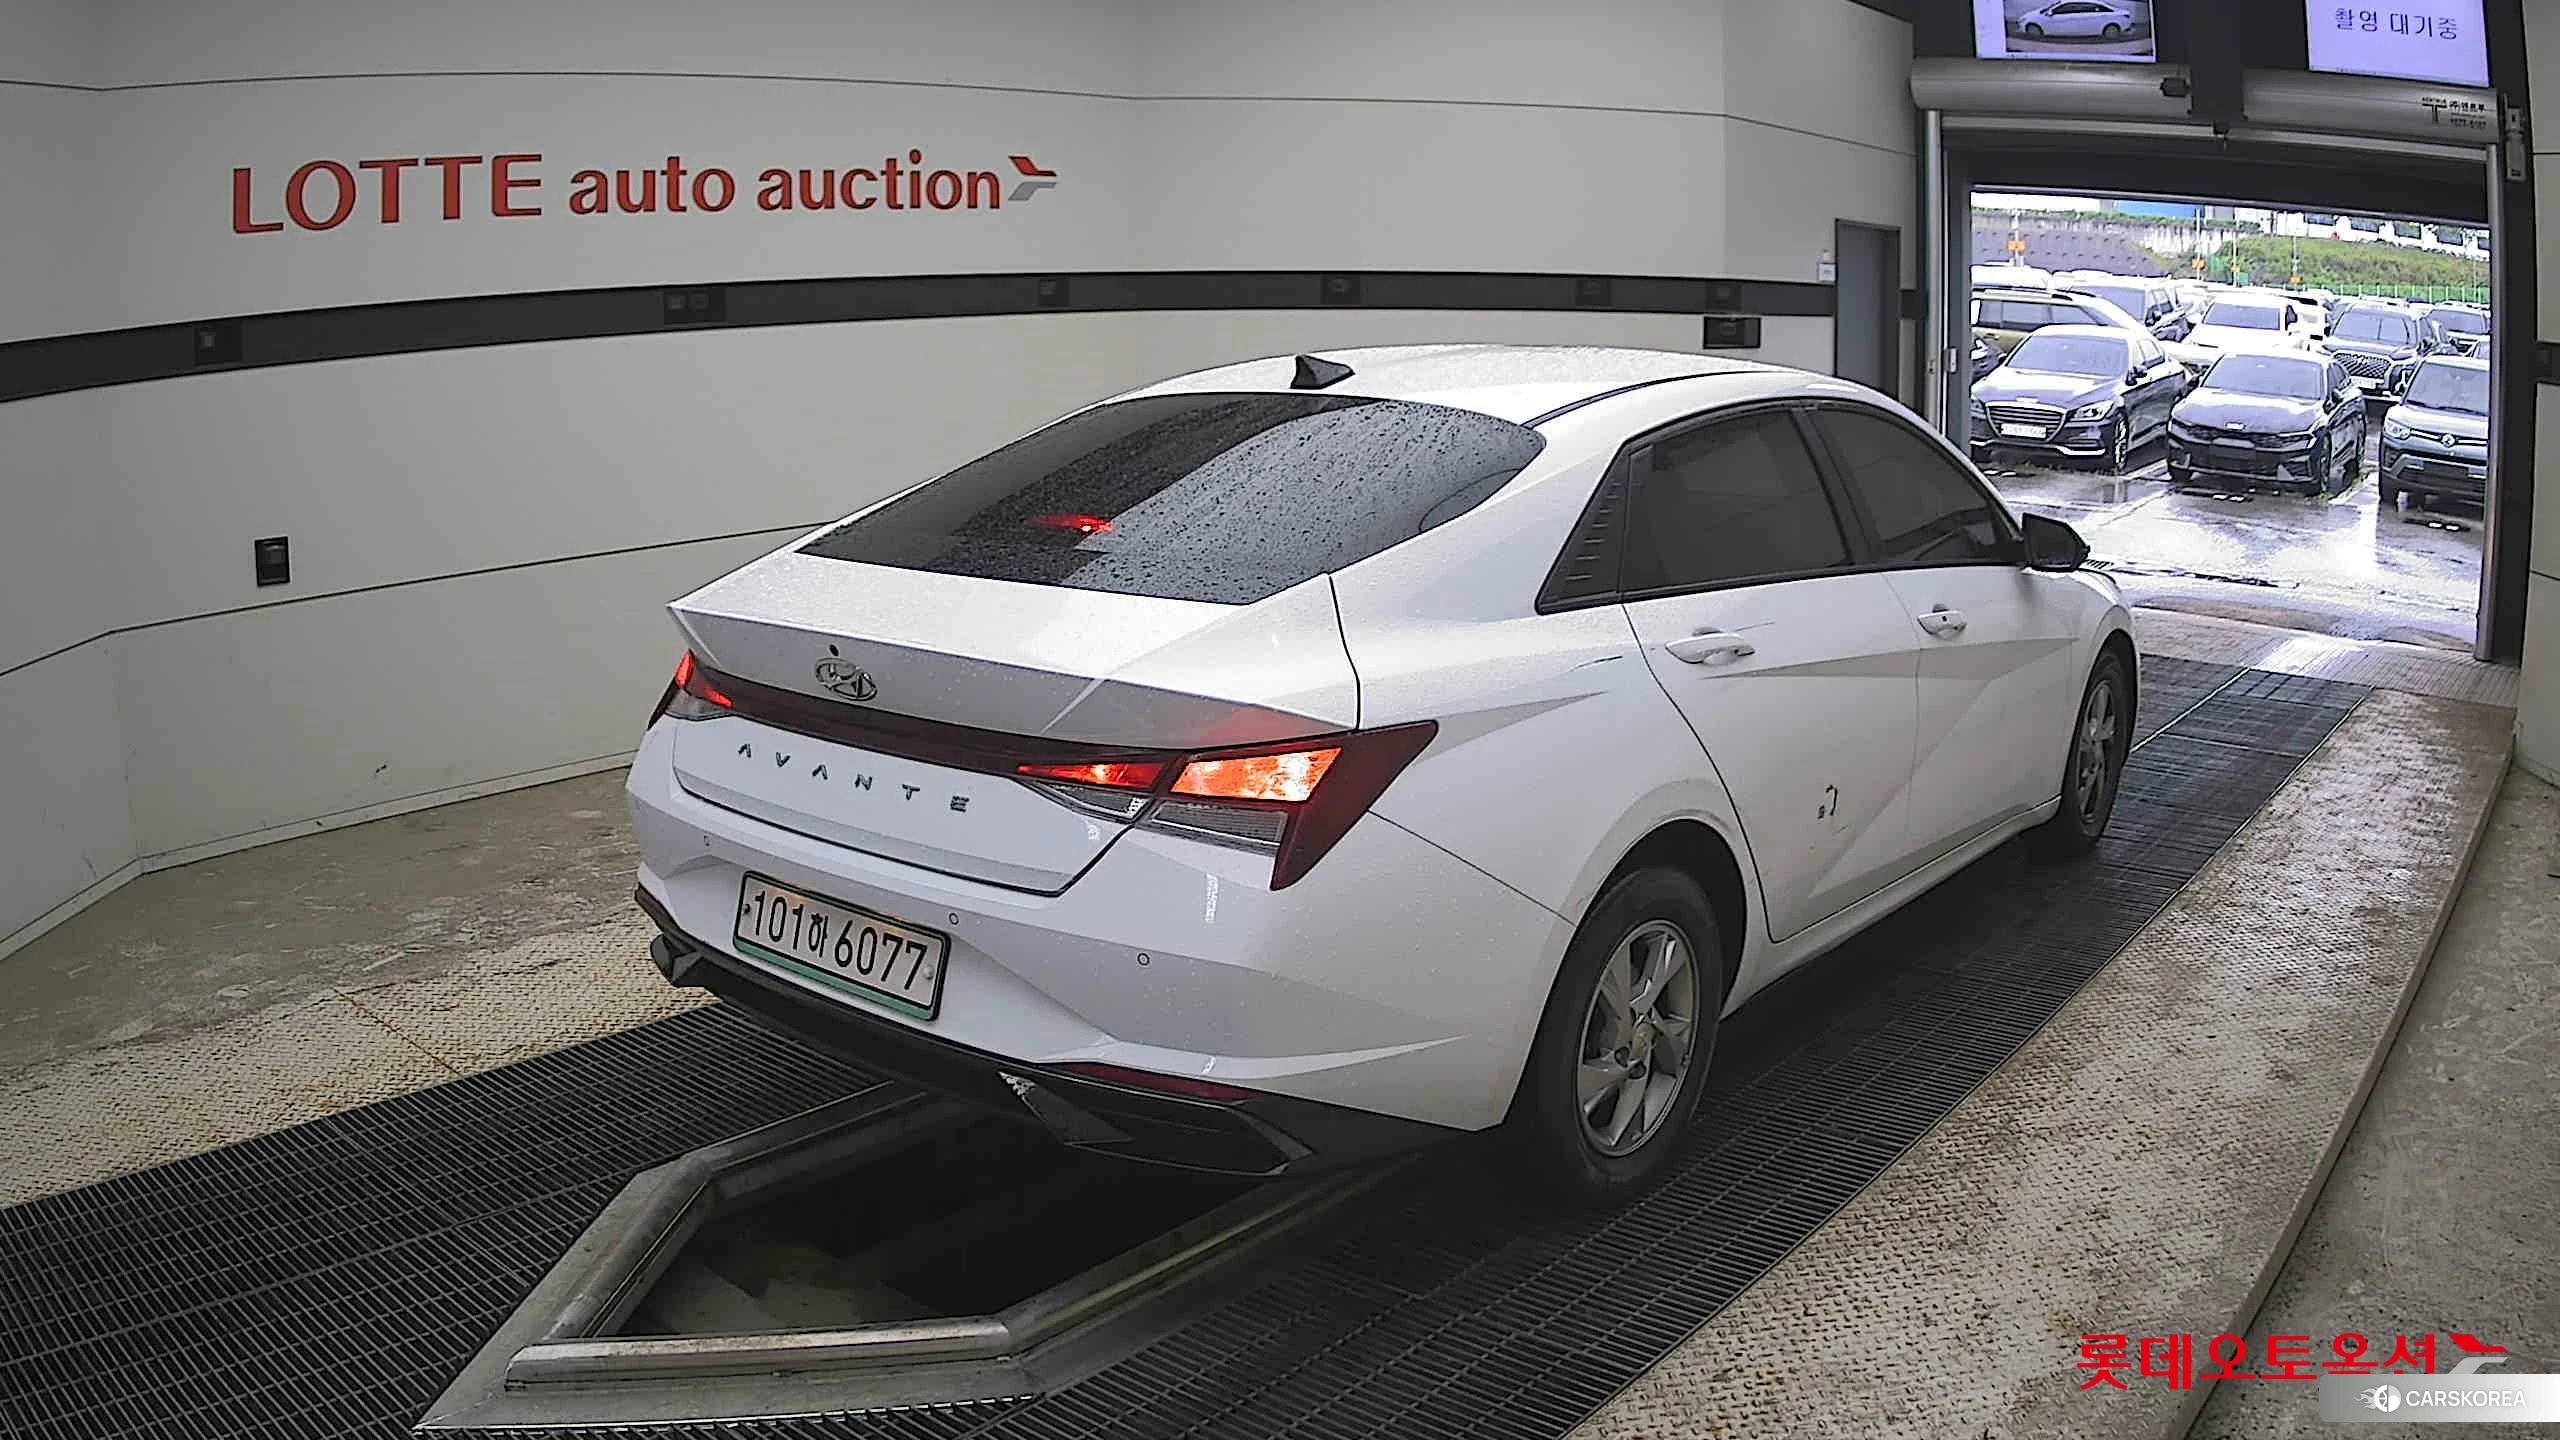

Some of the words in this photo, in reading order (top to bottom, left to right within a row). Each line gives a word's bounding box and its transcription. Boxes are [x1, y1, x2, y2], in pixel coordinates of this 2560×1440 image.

[2335, 7, 2378, 33] 촬영
[2390, 12, 2457, 41] 대기중
[232, 153, 543, 234] LOTTE
[568, 156, 736, 215] auto
[757, 149, 1002, 211] auction
[736, 742, 970, 813] AVANTE
